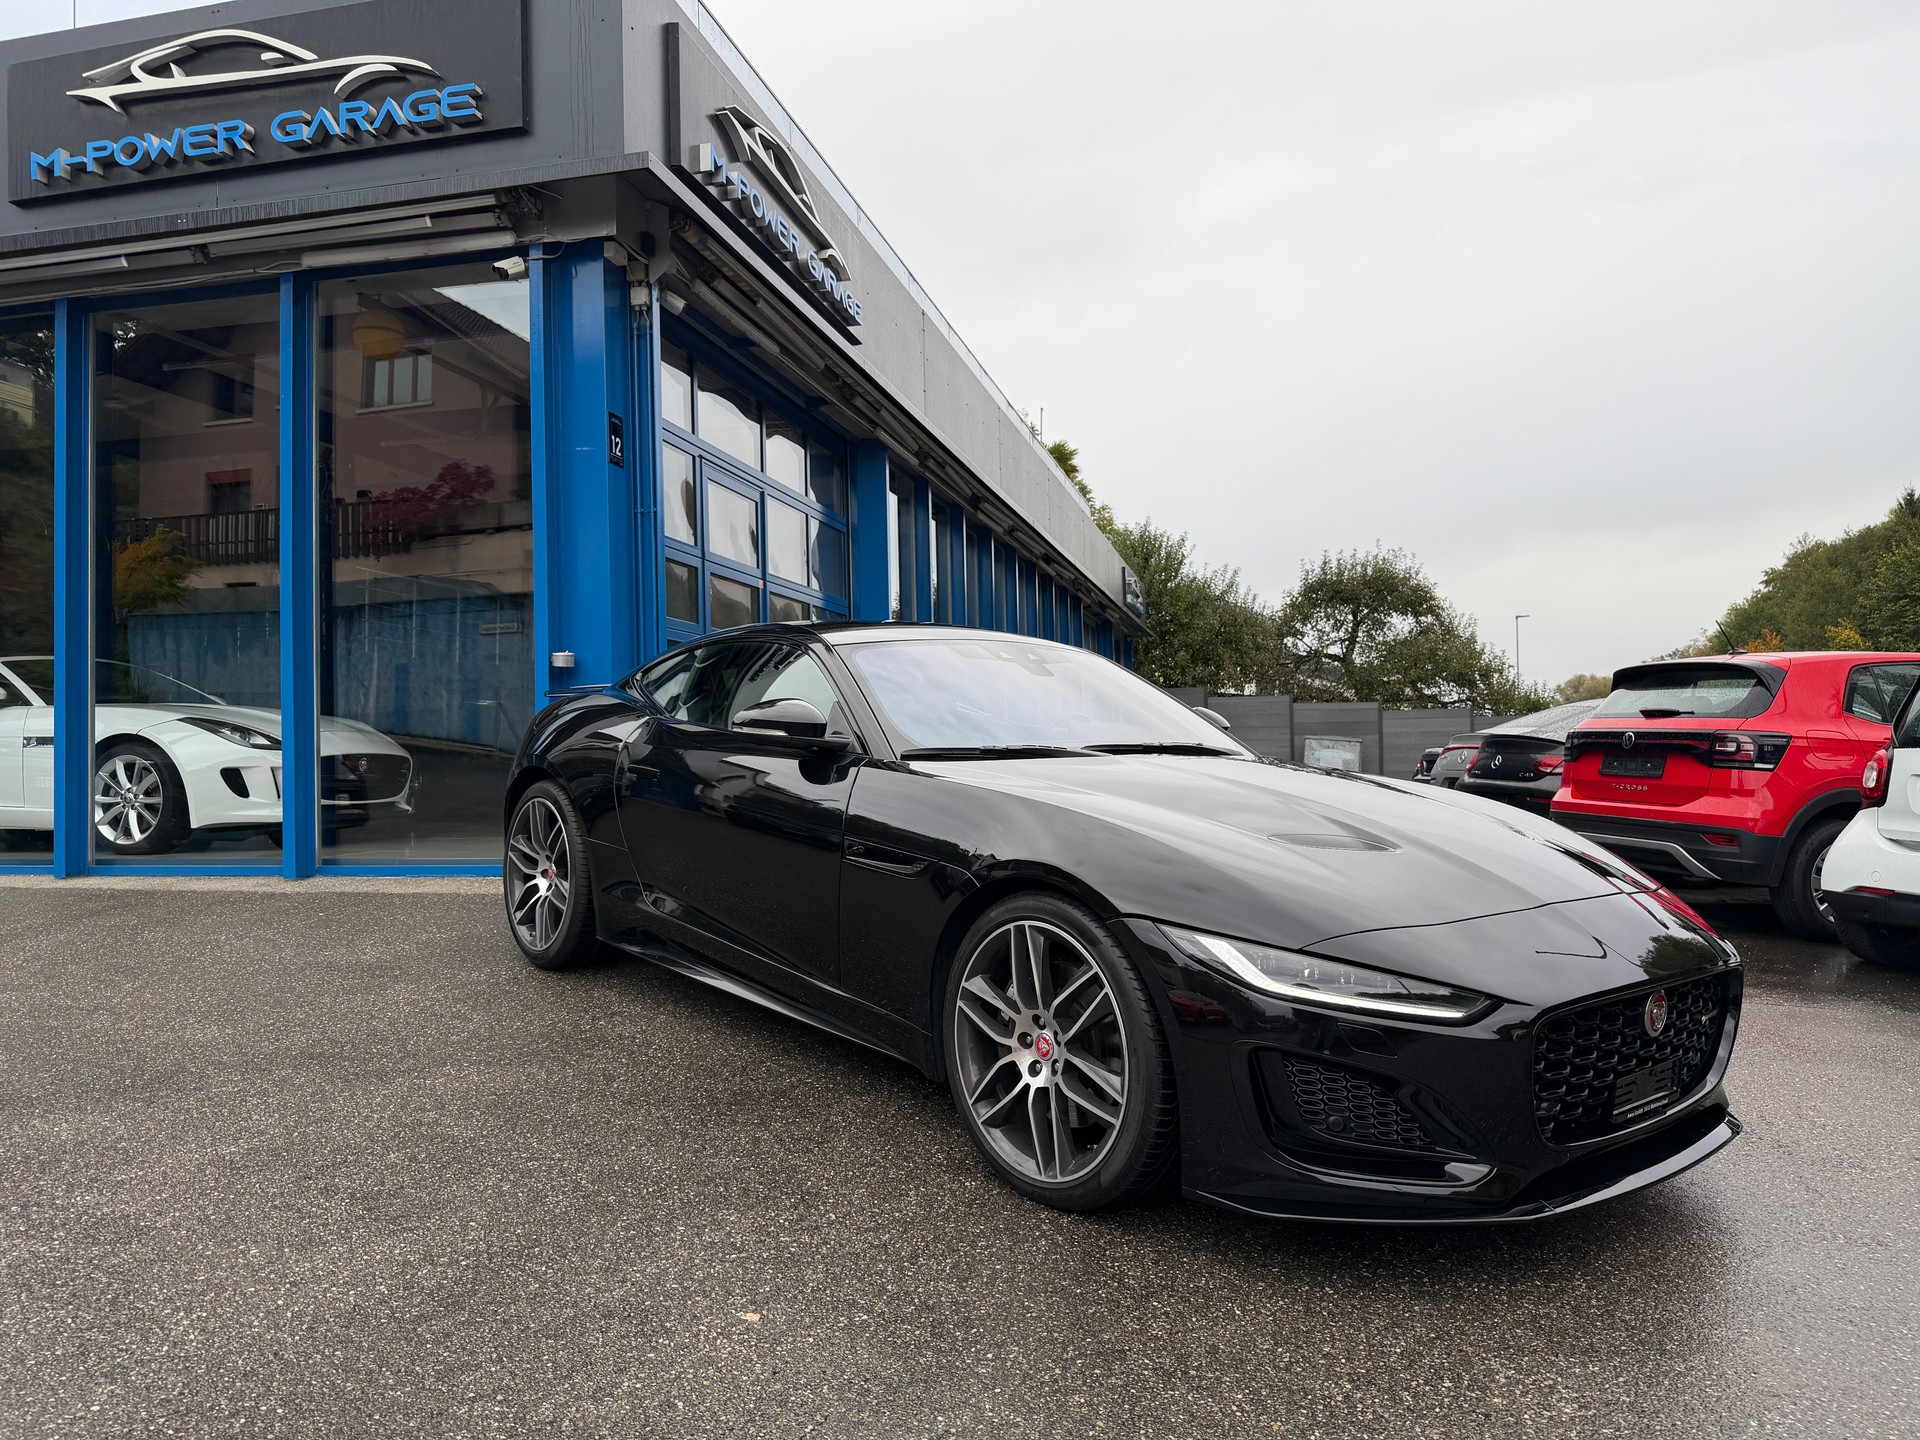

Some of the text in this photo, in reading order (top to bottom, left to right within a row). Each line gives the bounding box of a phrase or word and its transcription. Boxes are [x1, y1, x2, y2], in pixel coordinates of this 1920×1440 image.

[30, 82, 477, 181] M-POWER GARAGE
[710, 144, 863, 326] M-POWER GARAGE
[611, 434, 622, 457] 12
[1610, 783, 1649, 791] T-CROSS
